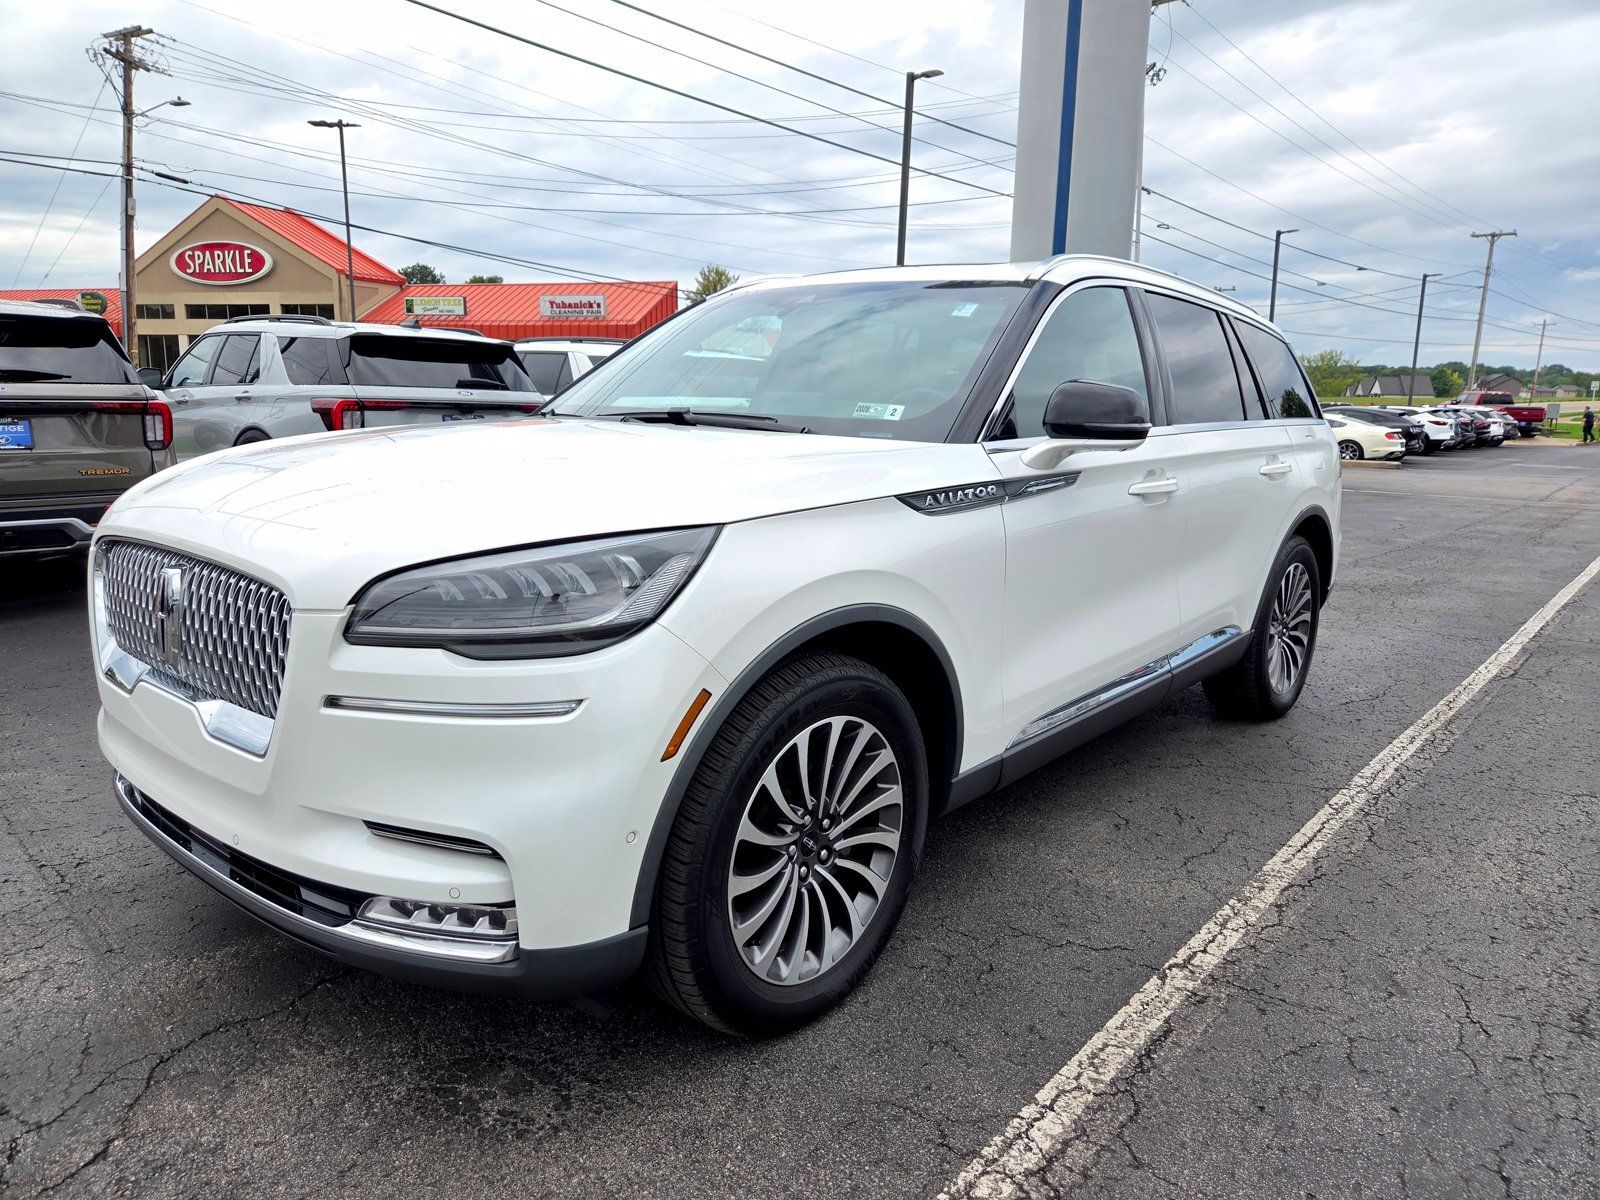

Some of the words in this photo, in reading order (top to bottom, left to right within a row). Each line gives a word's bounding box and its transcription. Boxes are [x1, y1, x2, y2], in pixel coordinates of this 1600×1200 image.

[184, 249, 253, 273] SPARKLE
[890, 407, 898, 417] 2
[925, 485, 997, 507] AVIATOR
